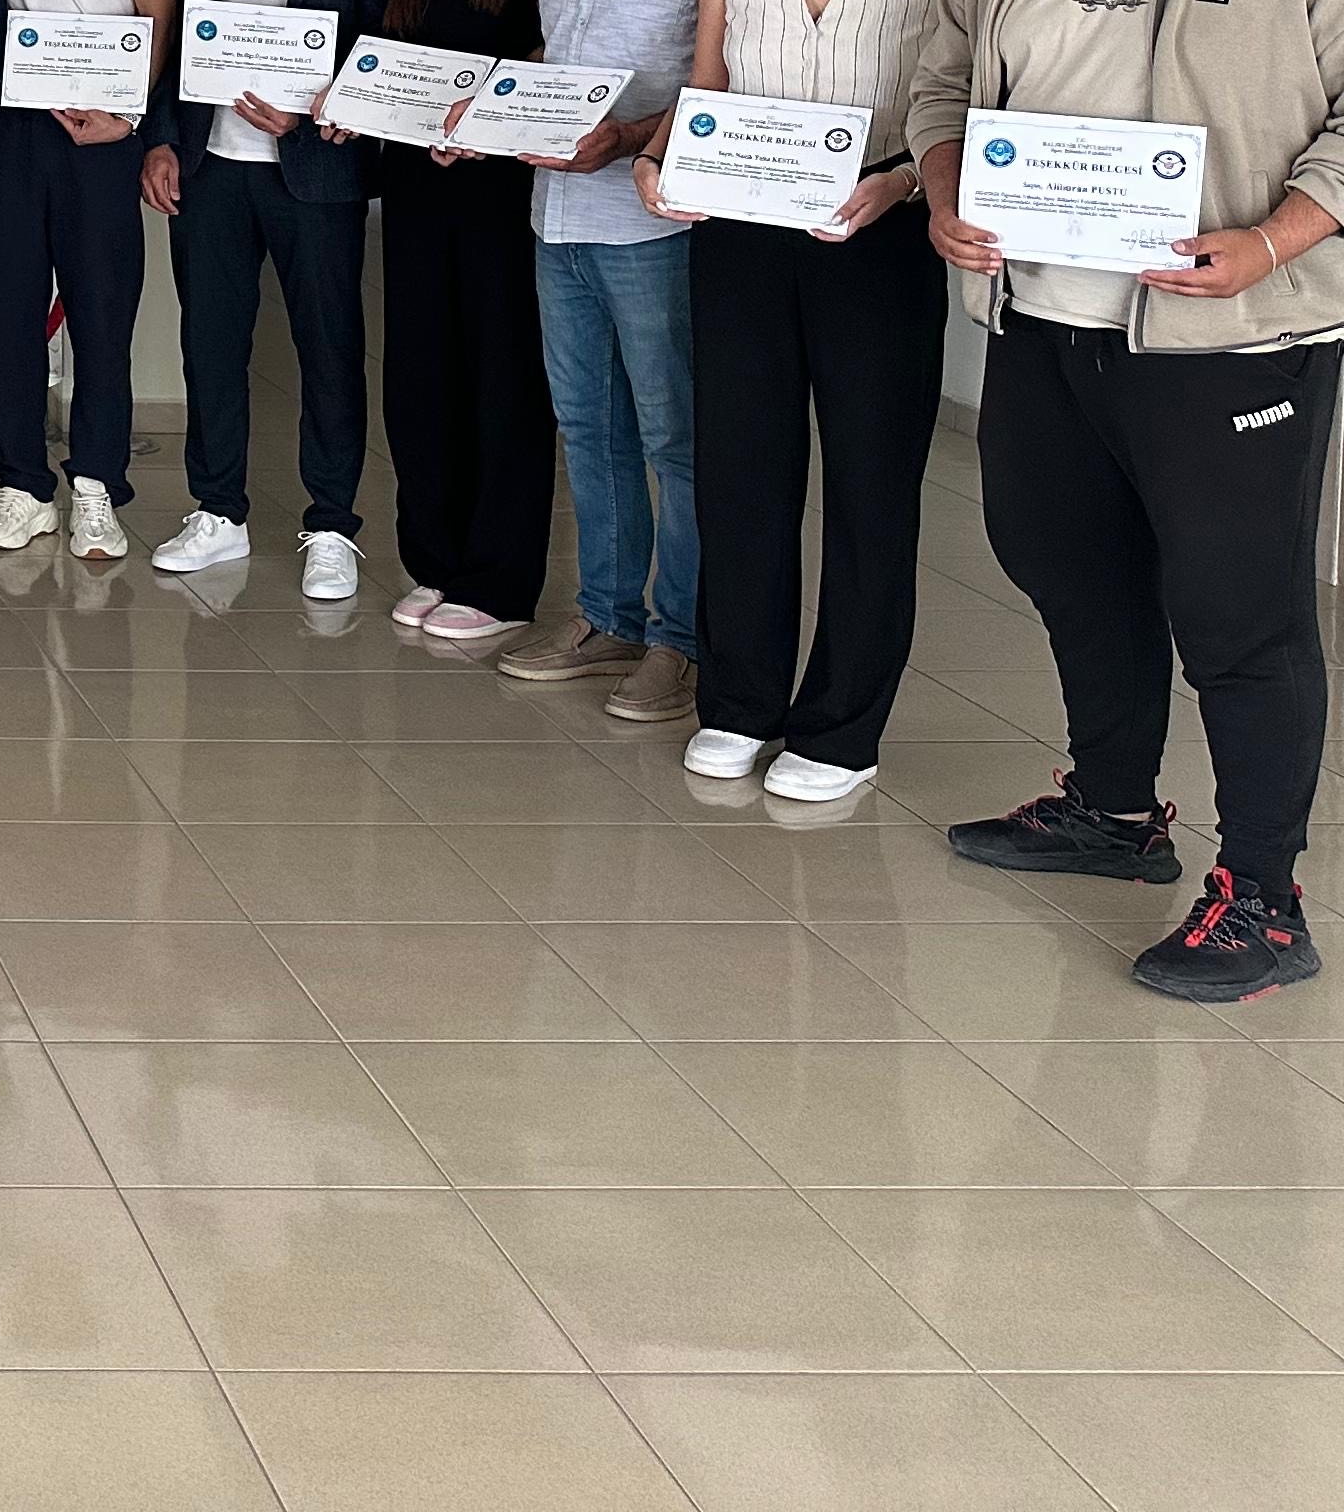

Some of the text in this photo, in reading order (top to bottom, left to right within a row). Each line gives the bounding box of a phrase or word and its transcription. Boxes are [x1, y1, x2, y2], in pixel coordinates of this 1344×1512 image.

[775, 134, 817, 148] BELGESİ
[1024, 158, 1143, 176] TEŞEKKÜR BELGESİ
[1092, 185, 1128, 197] PUSTU
